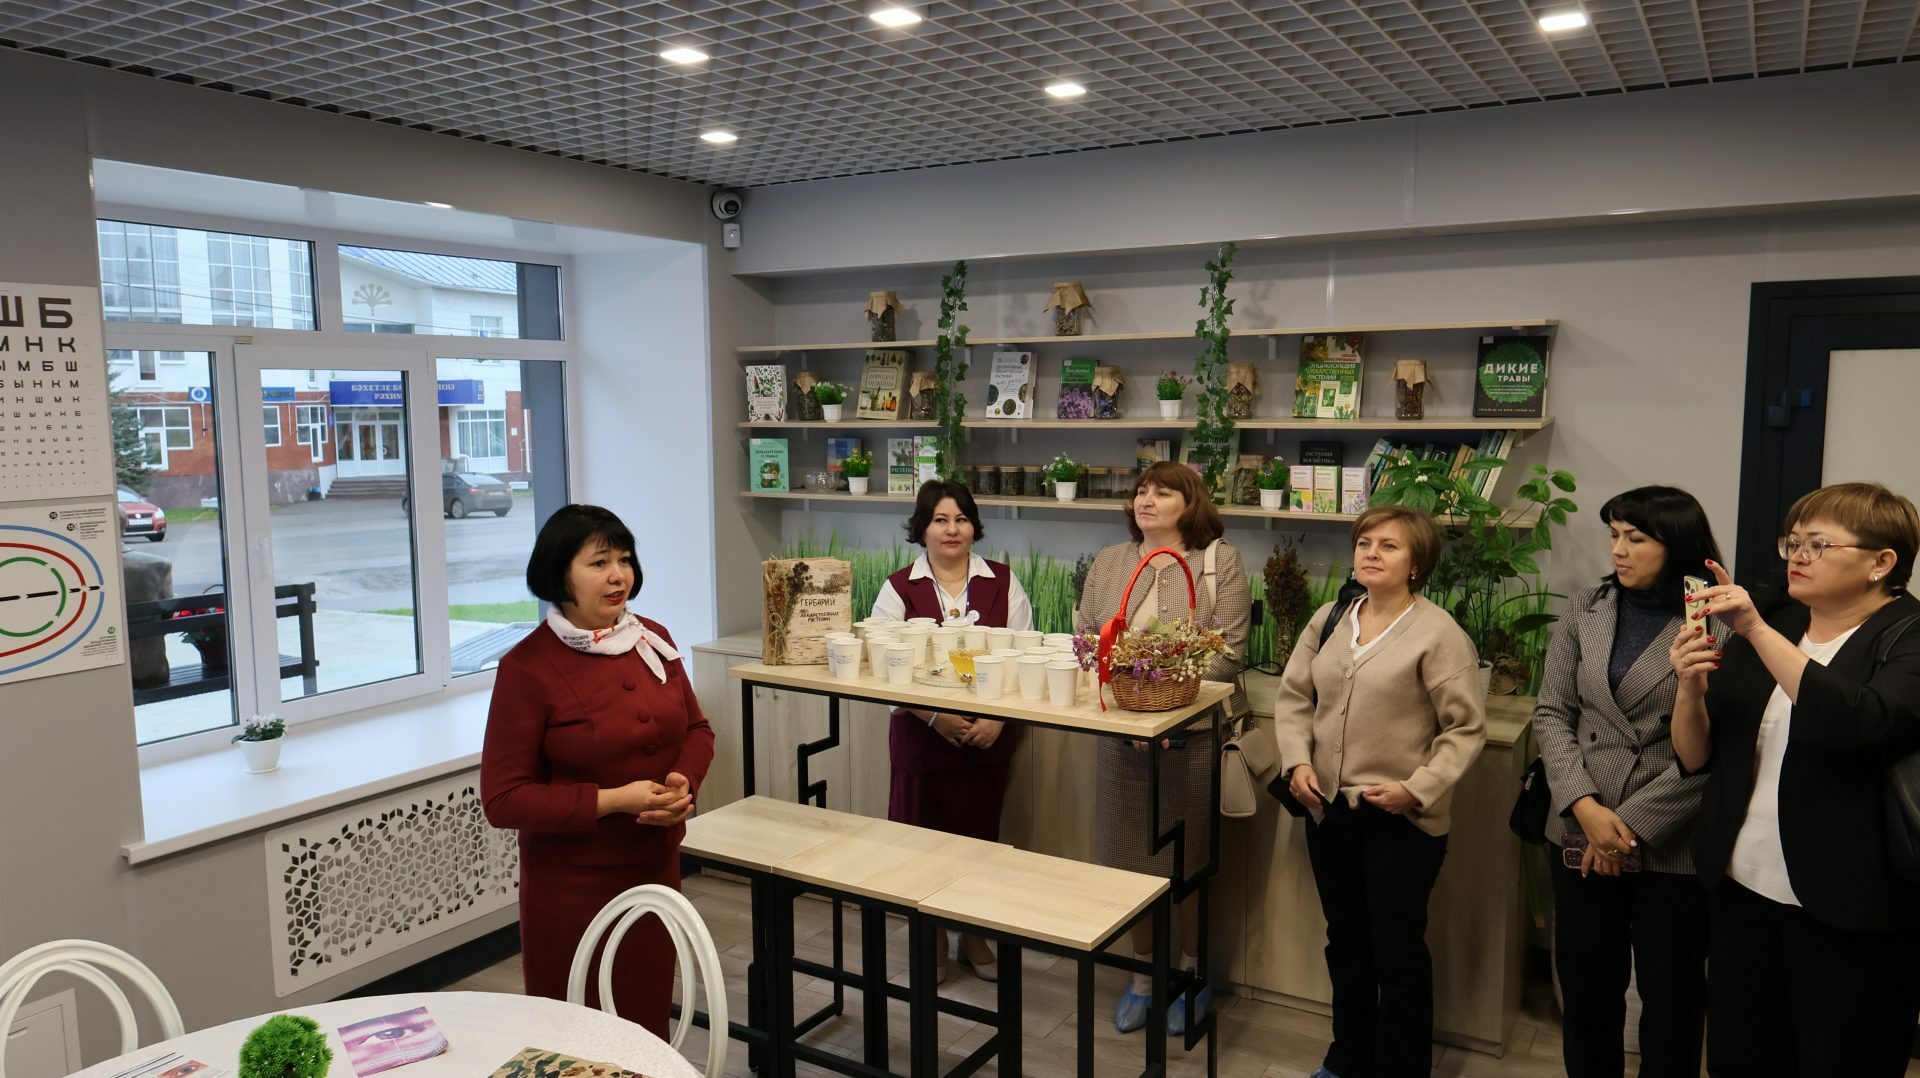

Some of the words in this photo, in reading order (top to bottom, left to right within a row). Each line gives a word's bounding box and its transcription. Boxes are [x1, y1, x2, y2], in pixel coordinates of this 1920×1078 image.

[0, 295, 24, 328] Ш
[38, 297, 73, 329] Б
[25, 335, 44, 353] Н
[58, 336, 76, 353] К
[18, 360, 31, 372] М
[42, 360, 54, 372] Б
[65, 361, 78, 372] Ш
[1484, 363, 1538, 375] ДИКИЕ
[14, 379, 24, 389] Ы
[33, 379, 43, 388] Н
[51, 379, 61, 388] К
[69, 379, 79, 388] М
[35, 396, 44, 404] Ш
[800, 598, 836, 606] ГЕРБАРИЙ
